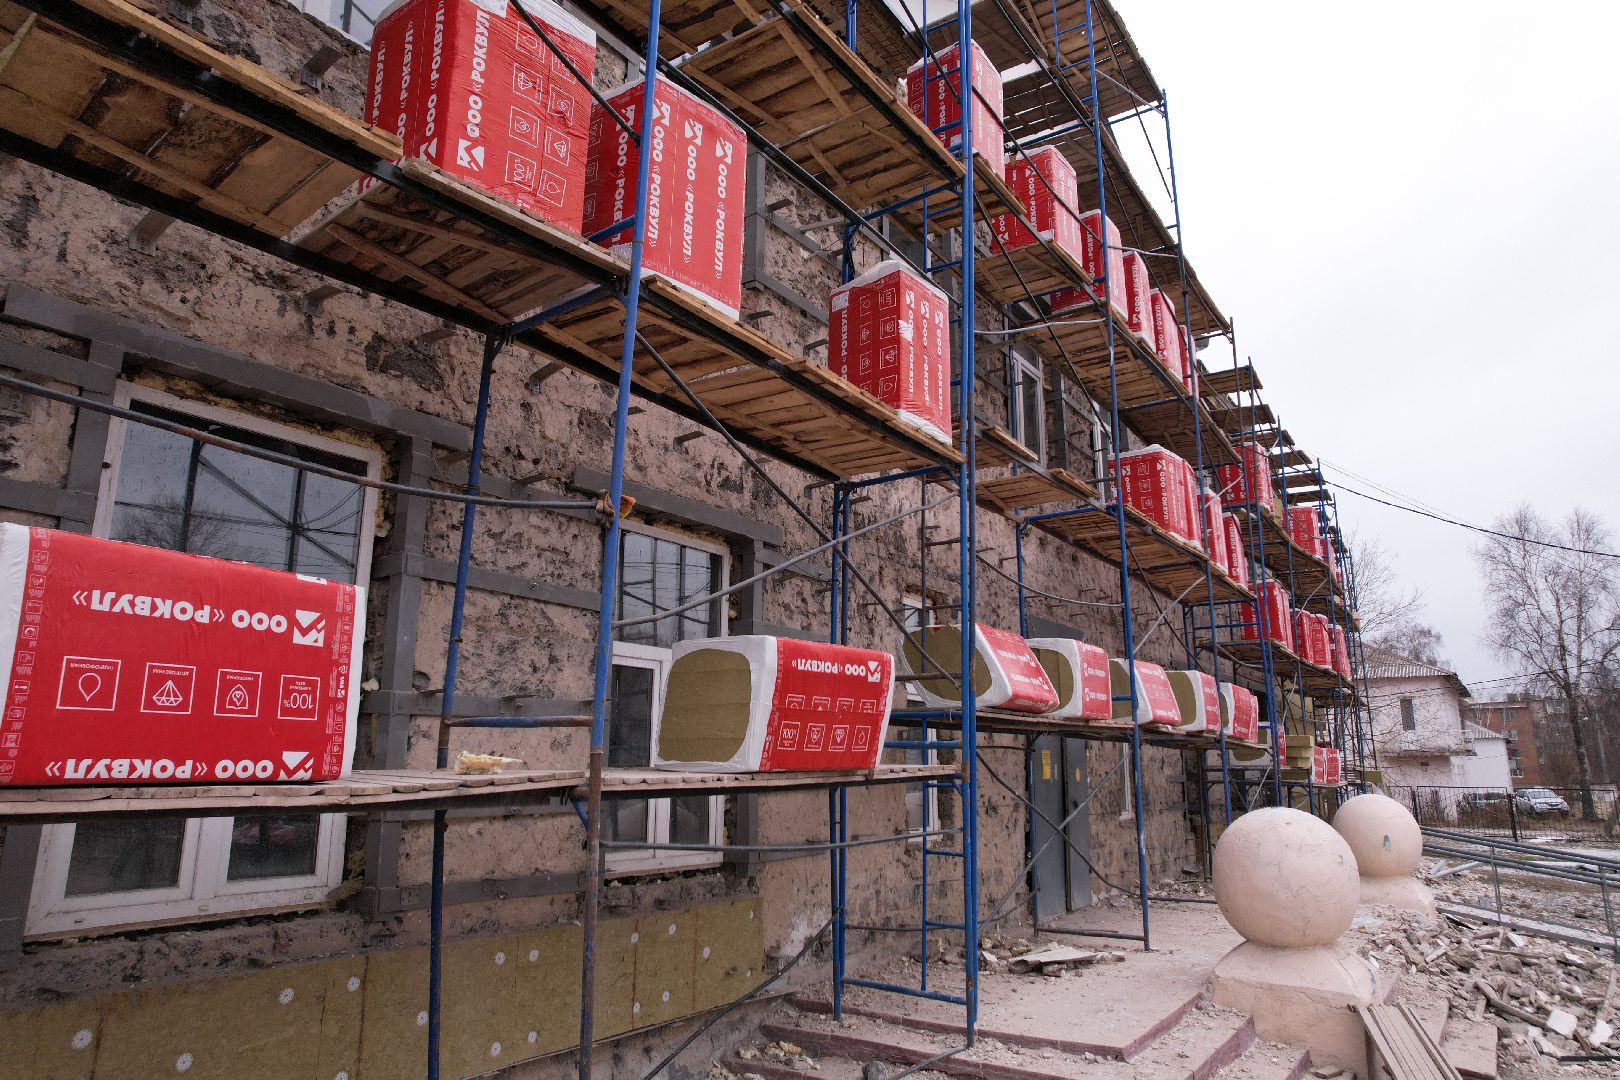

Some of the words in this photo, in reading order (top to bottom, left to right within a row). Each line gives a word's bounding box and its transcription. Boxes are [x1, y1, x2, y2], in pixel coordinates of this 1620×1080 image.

[471, 10, 490, 92] «РОКВУЛ
[396, 112, 406, 139] ОО
[426, 94, 437, 136] ООО
[466, 94, 482, 138] ООО
[616, 132, 628, 167] ООО
[652, 126, 664, 162] ООО
[688, 144, 697, 181] ООО
[718, 164, 728, 199] ООО
[648, 165, 660, 248] «РОКВУЛ»
[683, 185, 694, 264] «РОКВУЛ»
[715, 202, 726, 280] «РОКВУЛ»
[72, 589, 225, 624] «РОКВУЛ»
[232, 609, 287, 634] ООО
[844, 663, 866, 677] ООО
[283, 692, 314, 709] 100%
[44, 758, 207, 779] «РОКВУЛ»
[215, 759, 273, 779] ООО
